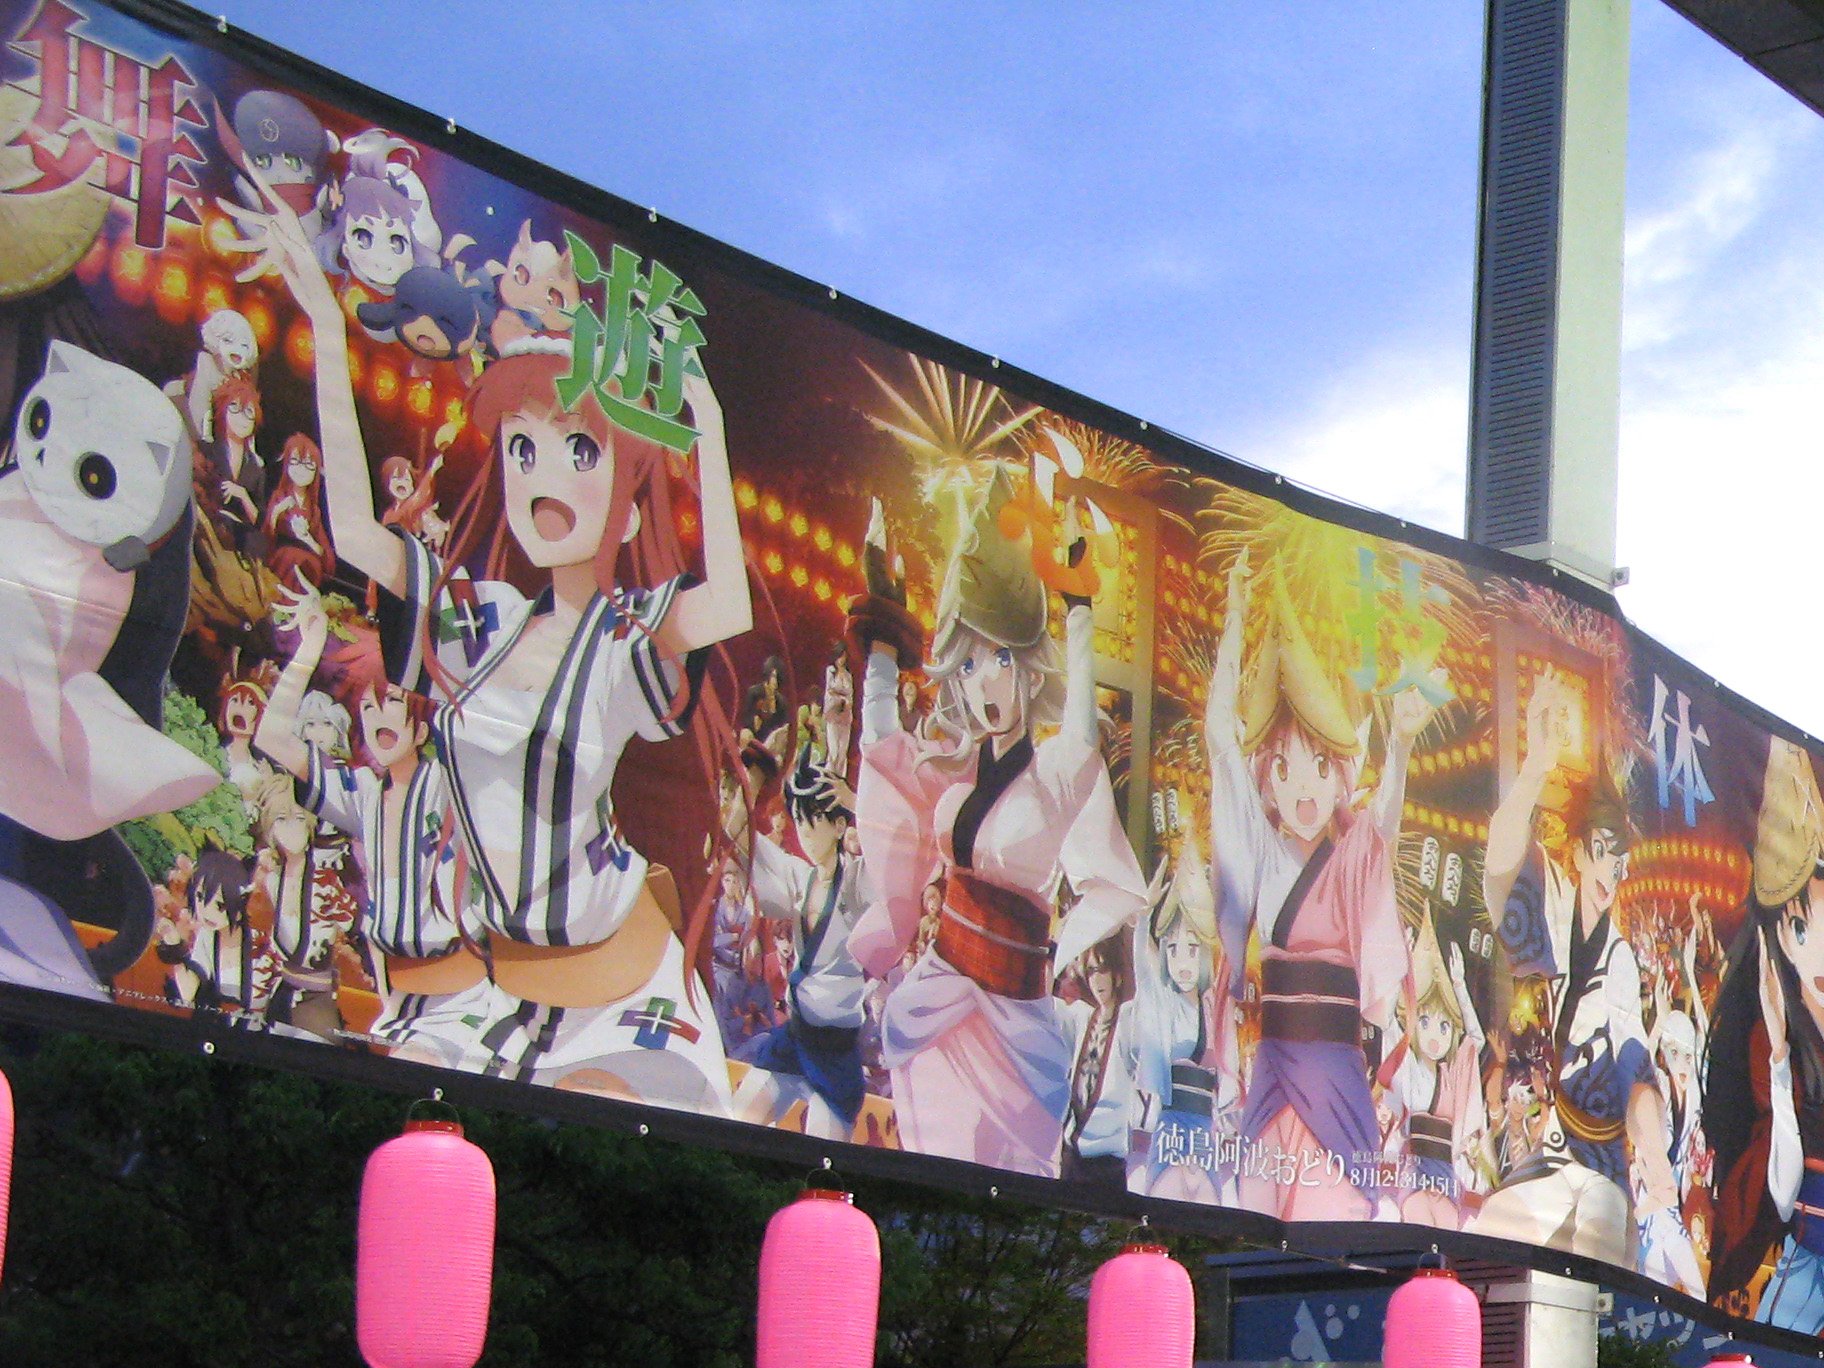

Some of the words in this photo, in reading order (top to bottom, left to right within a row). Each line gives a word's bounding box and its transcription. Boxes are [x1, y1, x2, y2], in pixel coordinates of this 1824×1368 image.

[555, 229, 709, 454] 遊
[1647, 672, 1716, 828] 体
[1156, 1120, 1347, 1188] 徳島阿波おどり
